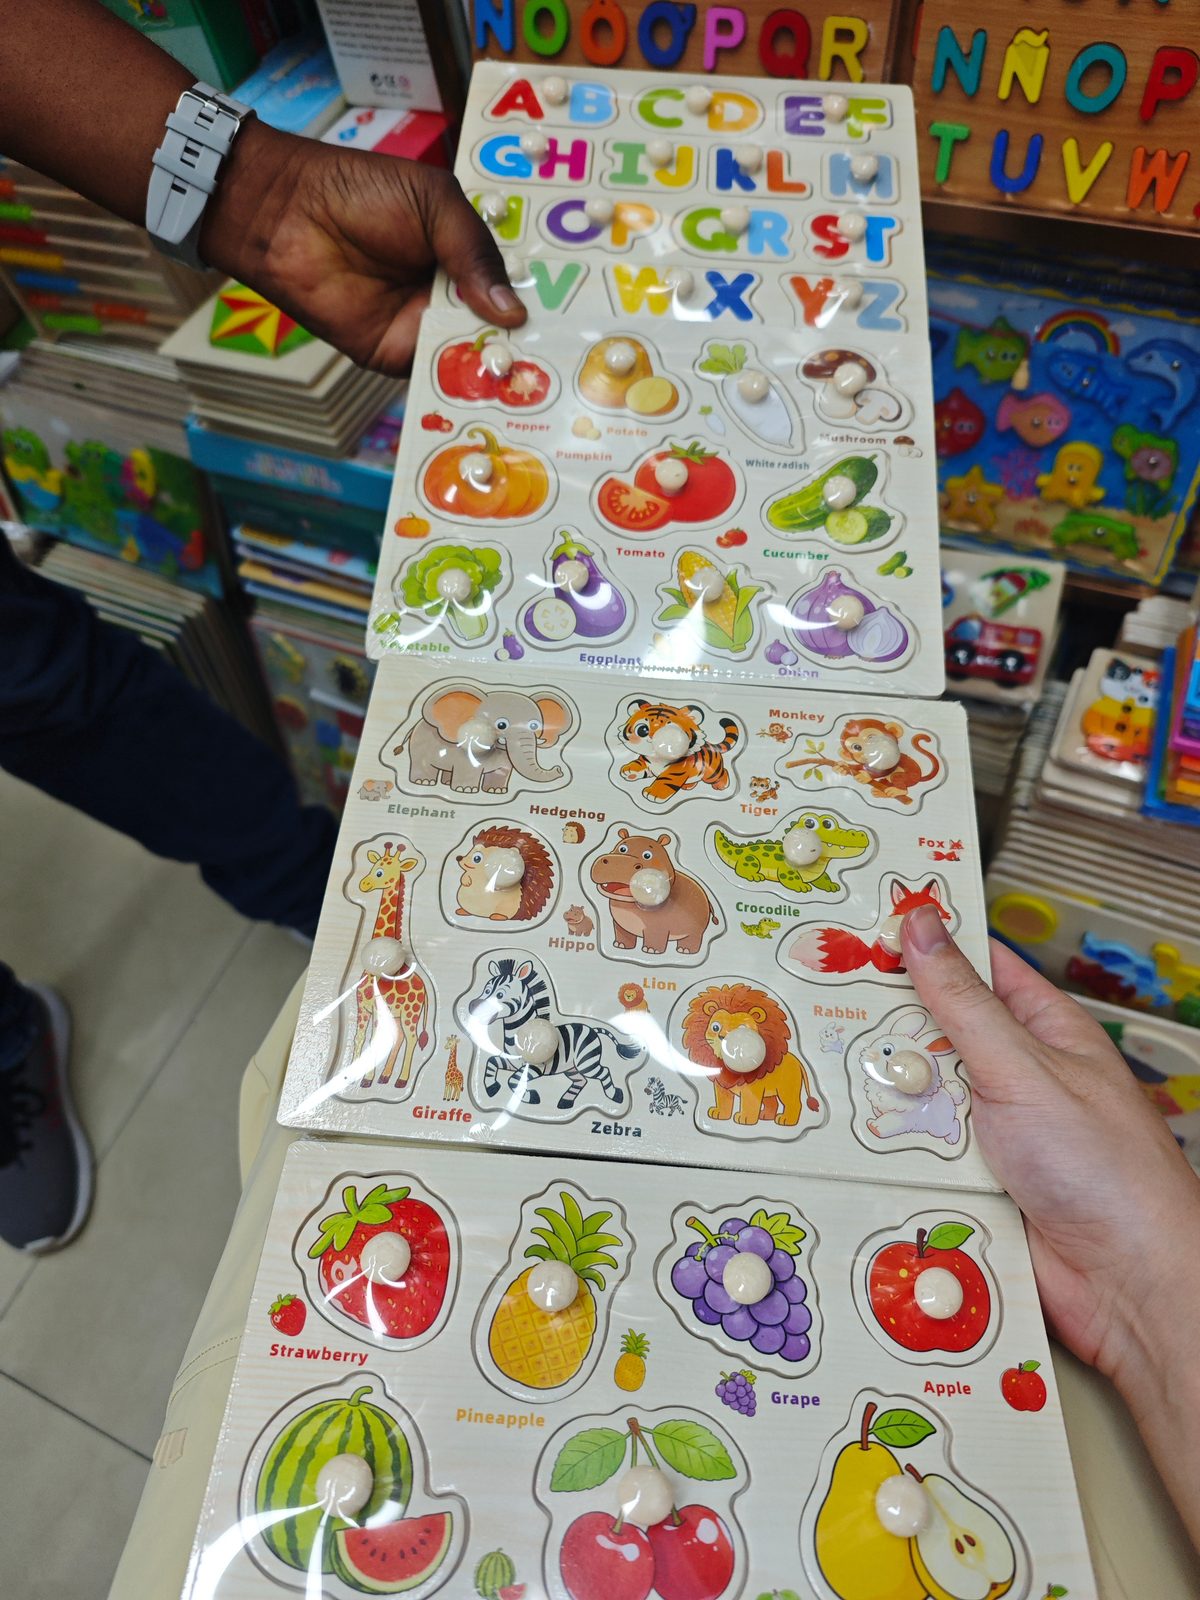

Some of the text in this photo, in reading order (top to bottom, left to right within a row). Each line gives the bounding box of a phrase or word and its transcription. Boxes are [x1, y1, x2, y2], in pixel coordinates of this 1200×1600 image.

[474, 0, 514, 52] N
[523, 0, 569, 56] O
[703, 7, 745, 71] P
[760, 9, 810, 79] Q
[819, 16, 868, 82] R
[931, 26, 1199, 120] N Ñ O P
[491, 79, 544, 120] A
[569, 82, 613, 123] B
[929, 121, 1190, 213] T U V W
[529, 260, 582, 311] V
[704, 271, 754, 321] X
[506, 421, 551, 433] Pepper
[606, 426, 648, 437] Potato
[819, 432, 887, 445] Mushroom
[556, 450, 613, 462] Pumpkin
[745, 459, 810, 471] White radish
[616, 547, 665, 559] Tomato
[763, 549, 830, 561] Cucumber
[579, 653, 642, 667] Eggplant
[769, 709, 825, 723] Monkey
[387, 803, 456, 819] Elephant
[529, 805, 606, 822] Hedgehog
[740, 804, 778, 816] Tiger
[918, 837, 945, 848] Fox
[735, 901, 801, 917] Crocodile
[548, 937, 595, 953] Hippo
[643, 977, 677, 991] Lion
[813, 1005, 868, 1020] Rabbit
[412, 1105, 473, 1123] Giraffe
[591, 1121, 642, 1138] Zebra
[269, 1343, 369, 1366] Strawberry
[923, 1380, 972, 1396] Apple
[771, 1391, 821, 1408] Grape
[456, 1408, 546, 1429] Pineapple
